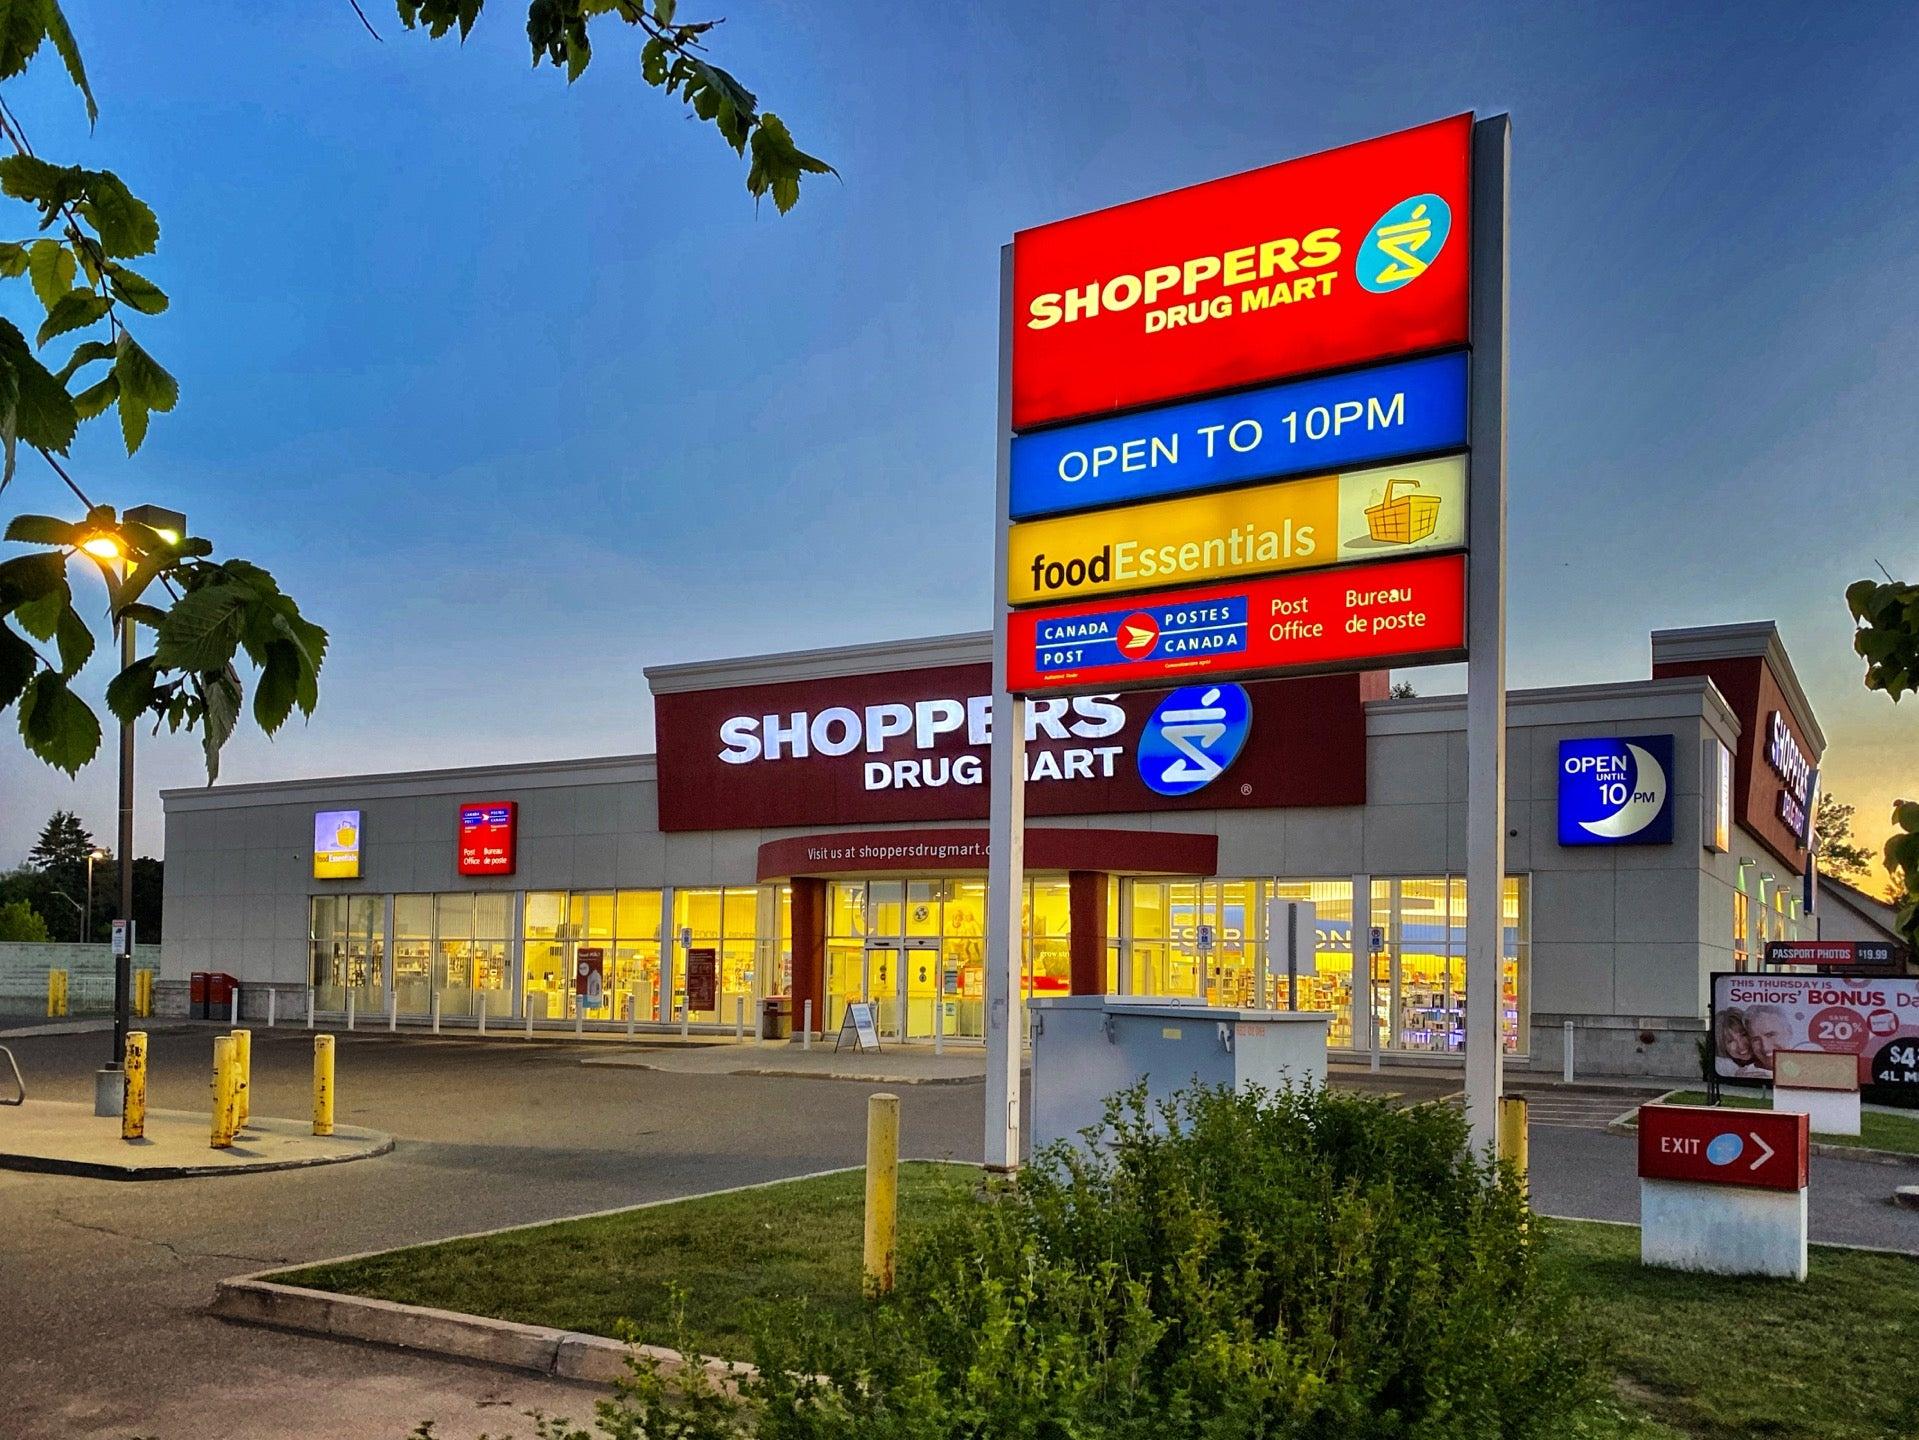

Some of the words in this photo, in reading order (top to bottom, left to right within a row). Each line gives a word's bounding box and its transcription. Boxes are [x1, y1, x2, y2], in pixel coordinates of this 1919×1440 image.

[1027, 227, 1341, 331] SHOPPERS
[1145, 295, 1233, 333] DRUG
[1241, 271, 1339, 313] MART
[1057, 433, 1179, 483] OPEN
[1198, 419, 1263, 457] TO
[1282, 393, 1405, 444] 10PM
[1032, 518, 1316, 592] foodEssentials
[1271, 597, 1309, 616] Post
[1345, 587, 1412, 608] Bureau
[1165, 607, 1230, 626] POSTES
[1345, 615, 1367, 634] de
[1372, 611, 1427, 636] poste
[1044, 620, 1109, 640] CANADA
[1269, 620, 1323, 642] Office
[1164, 633, 1238, 653] CANADA
[1044, 649, 1083, 665] POST
[865, 755, 983, 791] DRUG
[1024, 746, 1123, 782] ART
[1564, 754, 1628, 775] OPEN
[1596, 772, 1627, 781] UNTIL
[1598, 783, 1627, 806] 10
[1633, 791, 1655, 804] PM
[807, 847, 828, 860] Visit
[830, 848, 843, 859] us
[844, 846, 856, 858] at
[1772, 948, 1815, 959] PASSPORT
[1817, 948, 1851, 959] PHOTOS
[1859, 949, 1888, 960] $19.99
[1730, 979, 1754, 988] THIS
[1758, 980, 1818, 989] THURSDAY
[1821, 981, 1833, 989] IS
[1808, 990, 1886, 1007] BONUS
[1818, 1021, 1863, 1040] 20%
[1879, 1070, 1900, 1082] 4L
[1660, 1136, 1701, 1155] EXIT
